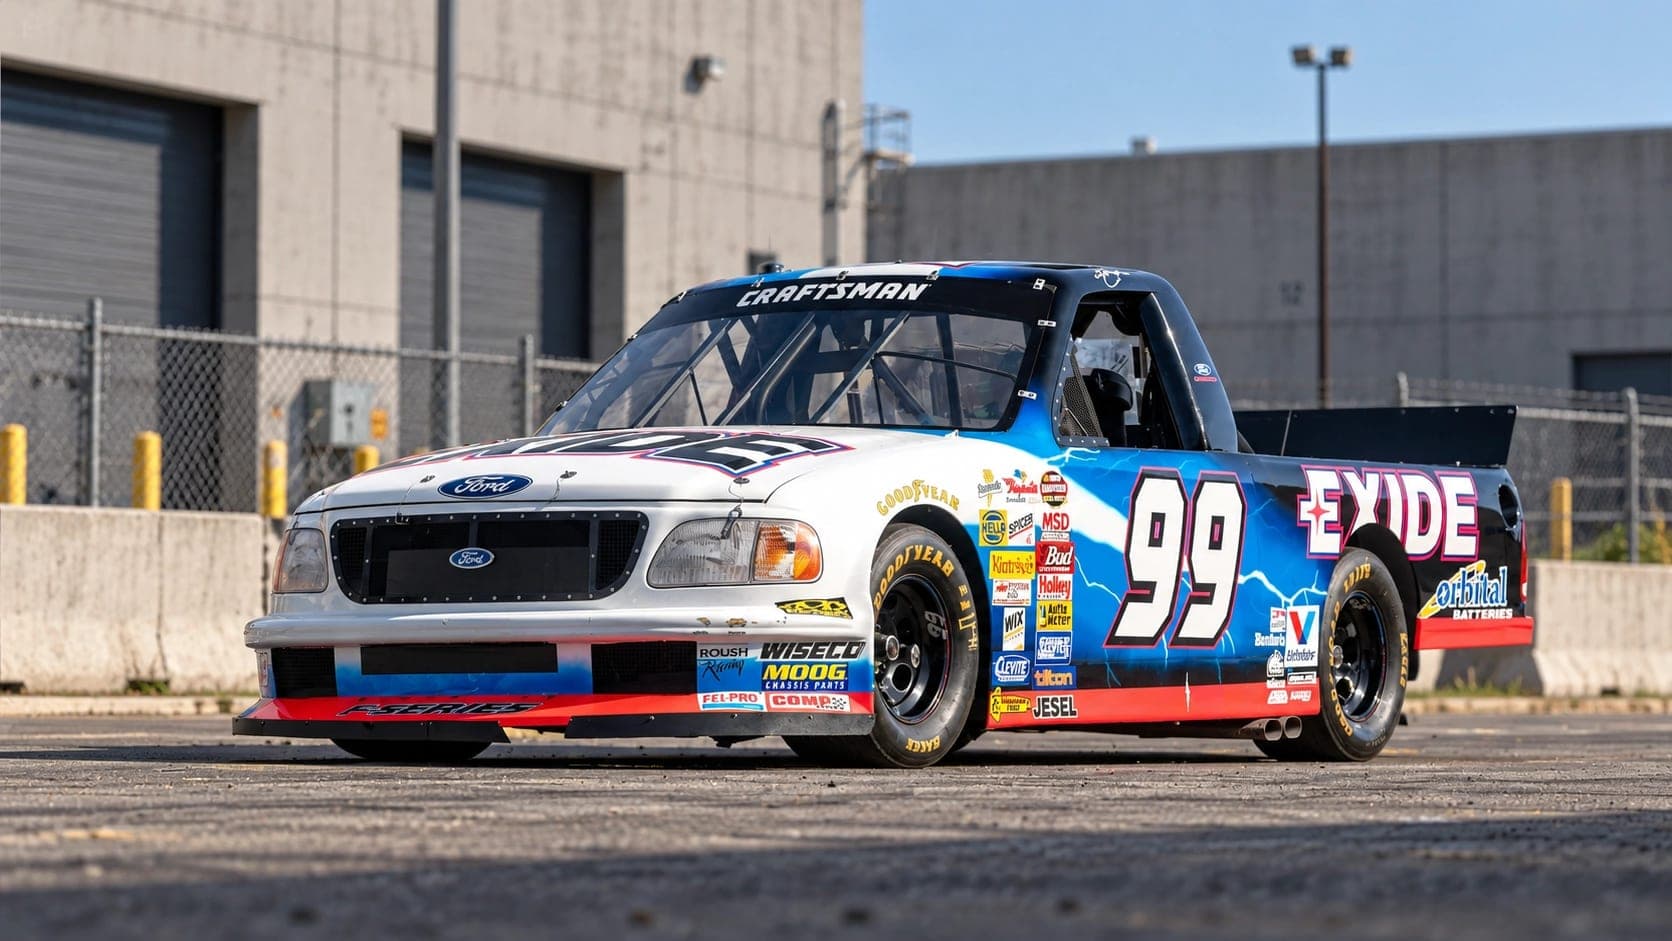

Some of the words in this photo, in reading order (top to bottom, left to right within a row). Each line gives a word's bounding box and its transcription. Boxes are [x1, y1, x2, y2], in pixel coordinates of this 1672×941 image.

[736, 282, 928, 307] CRAFTSMAN
[453, 476, 517, 493] Ford
[876, 479, 961, 516] GOODYEAR
[1042, 512, 1070, 530] MSD
[1297, 464, 1480, 562] EXIDE
[982, 522, 1006, 534] HELLA
[457, 550, 483, 565] Ford
[1045, 546, 1073, 566] Bud
[1103, 466, 1248, 649] 99
[1039, 575, 1072, 600] Holley
[1436, 566, 1509, 610] orbital
[1004, 610, 1024, 633] WIX
[1452, 608, 1513, 620] BATTERIES
[700, 648, 748, 658] ROUSH
[760, 642, 865, 660] WISECO
[763, 664, 847, 681] MOOG
[765, 681, 809, 690] CHASSIS
[703, 693, 758, 703] FEL-PRO
[772, 695, 832, 707] COMP
[1033, 696, 1077, 718] JESEL
[335, 702, 543, 718] F-SERIES
